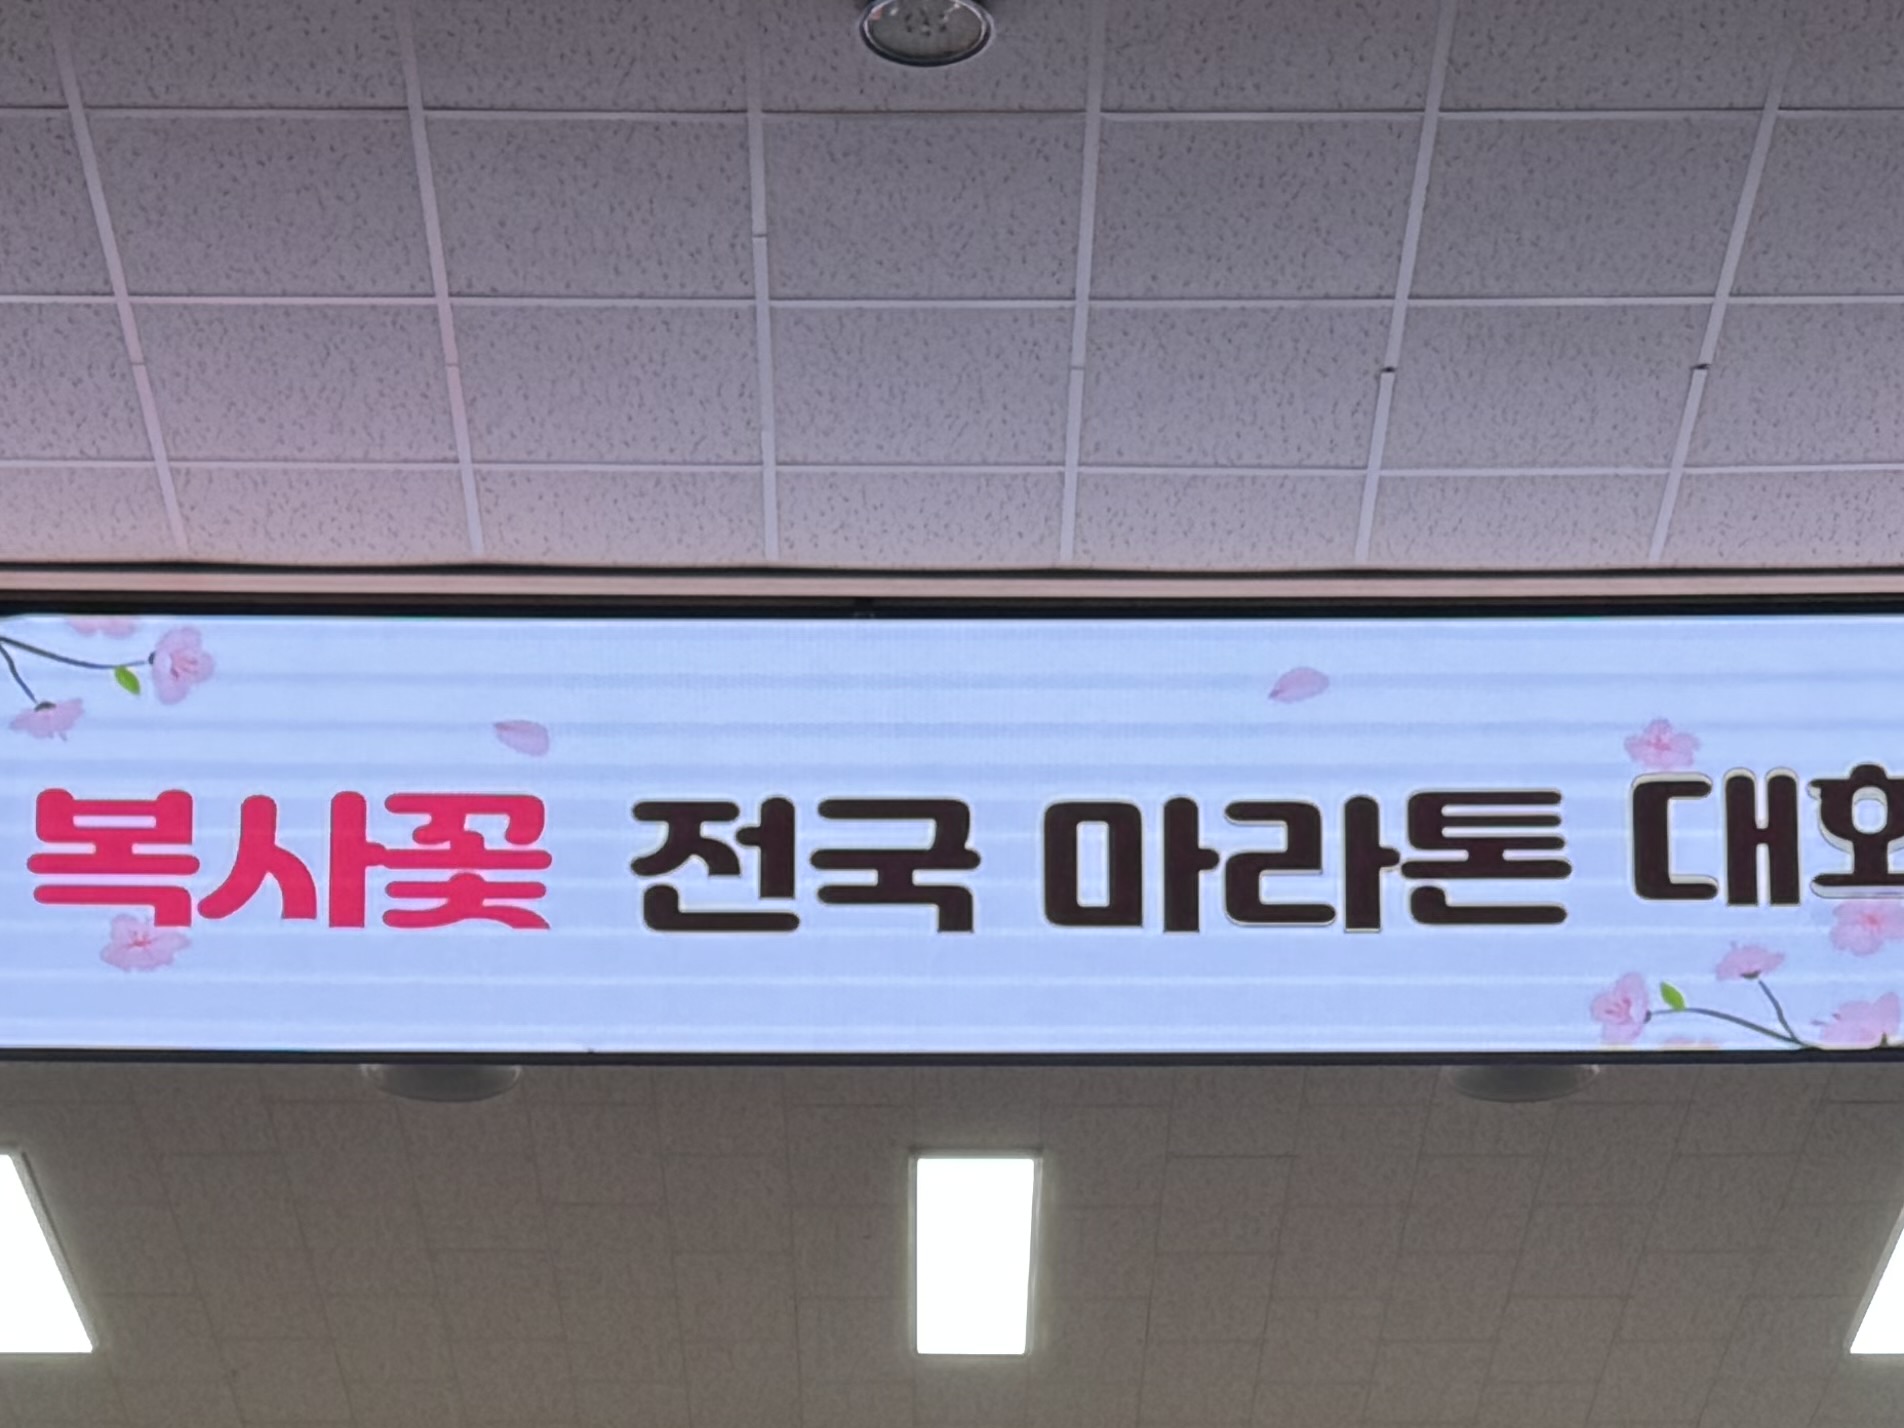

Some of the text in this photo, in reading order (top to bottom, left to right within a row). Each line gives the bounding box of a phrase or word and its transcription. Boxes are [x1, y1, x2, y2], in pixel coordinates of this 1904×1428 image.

[28, 787, 552, 930] 복사꽃
[629, 794, 982, 934] 전국
[1041, 789, 1573, 934] 마라톤
